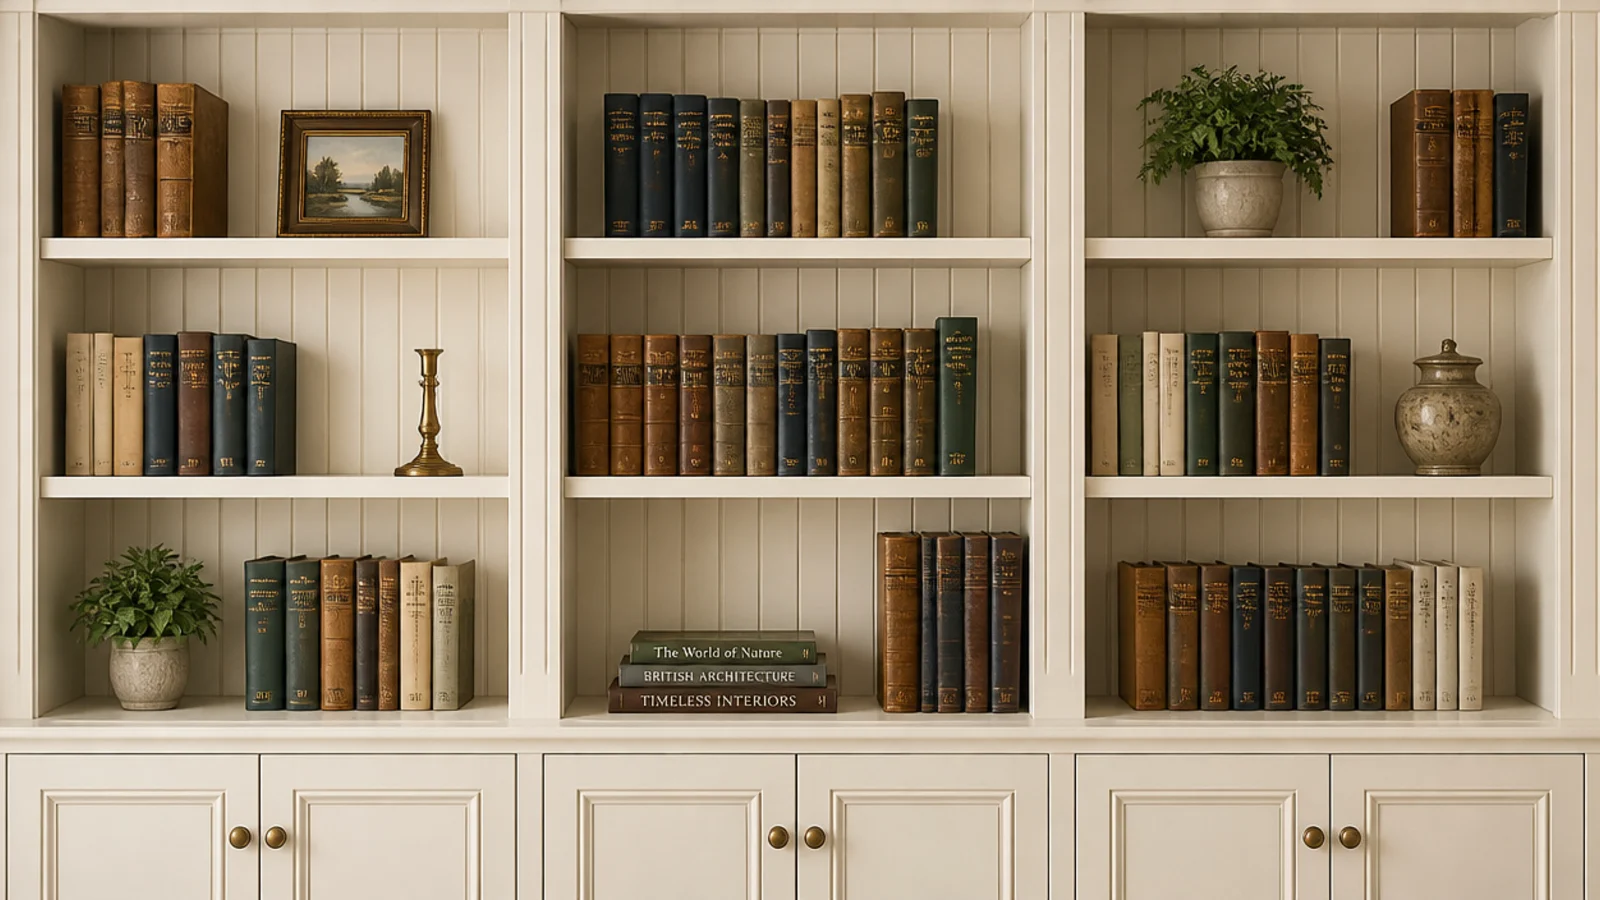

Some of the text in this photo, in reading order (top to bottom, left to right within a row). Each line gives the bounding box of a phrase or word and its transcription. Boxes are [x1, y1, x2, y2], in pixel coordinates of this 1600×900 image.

[653, 646, 679, 658] The
[682, 646, 720, 659] World
[724, 646, 738, 659] of
[643, 670, 796, 683] BRITISH ARCHITECTURE
[640, 694, 797, 707] TIMELESS INTERIORS
